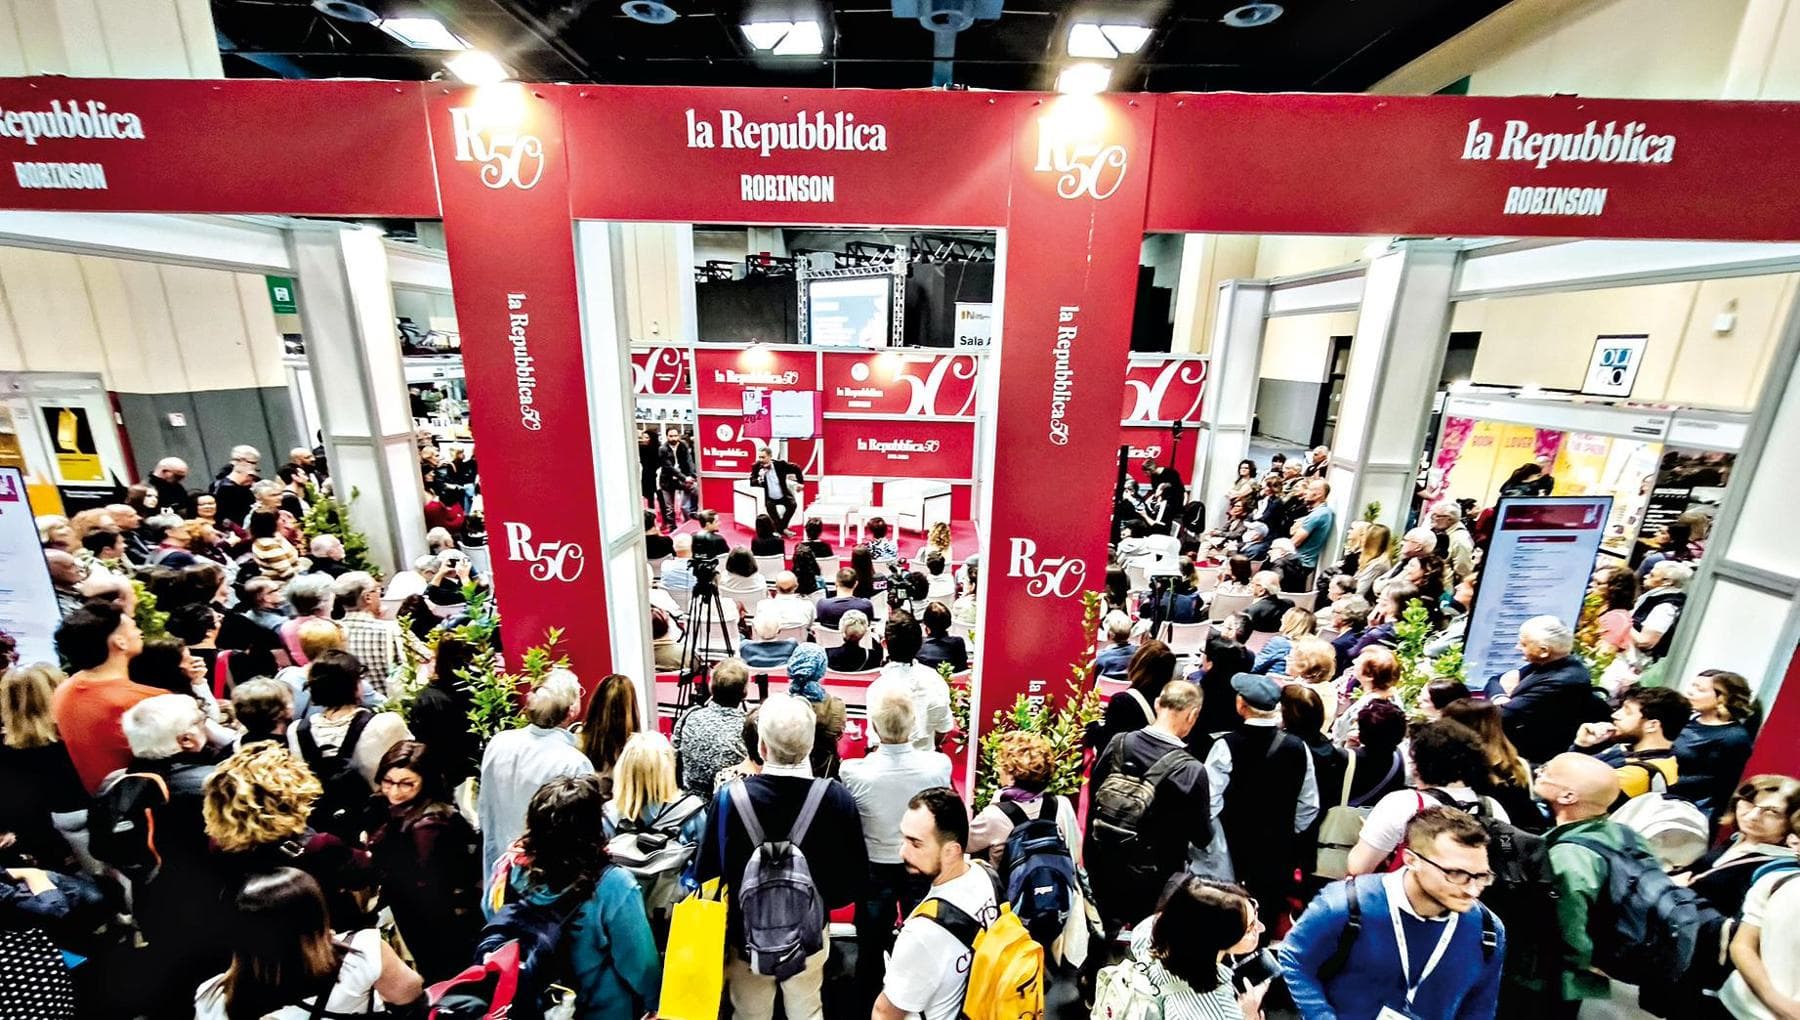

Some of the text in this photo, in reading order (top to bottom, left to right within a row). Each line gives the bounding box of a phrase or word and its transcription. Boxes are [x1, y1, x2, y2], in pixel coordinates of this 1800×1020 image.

[685, 108, 888, 157] la Repubblica
[1460, 117, 1677, 169] la Repubblica
[12, 161, 108, 190] ROBINSON
[740, 173, 835, 203] ROBINSON
[1503, 186, 1609, 216] ROBINSON
[507, 292, 528, 310] la
[1059, 305, 1080, 322] la
[960, 335, 984, 346] Sala
[503, 522, 584, 583] R50
[1007, 537, 1087, 598] R50
[1028, 680, 1047, 693] la
